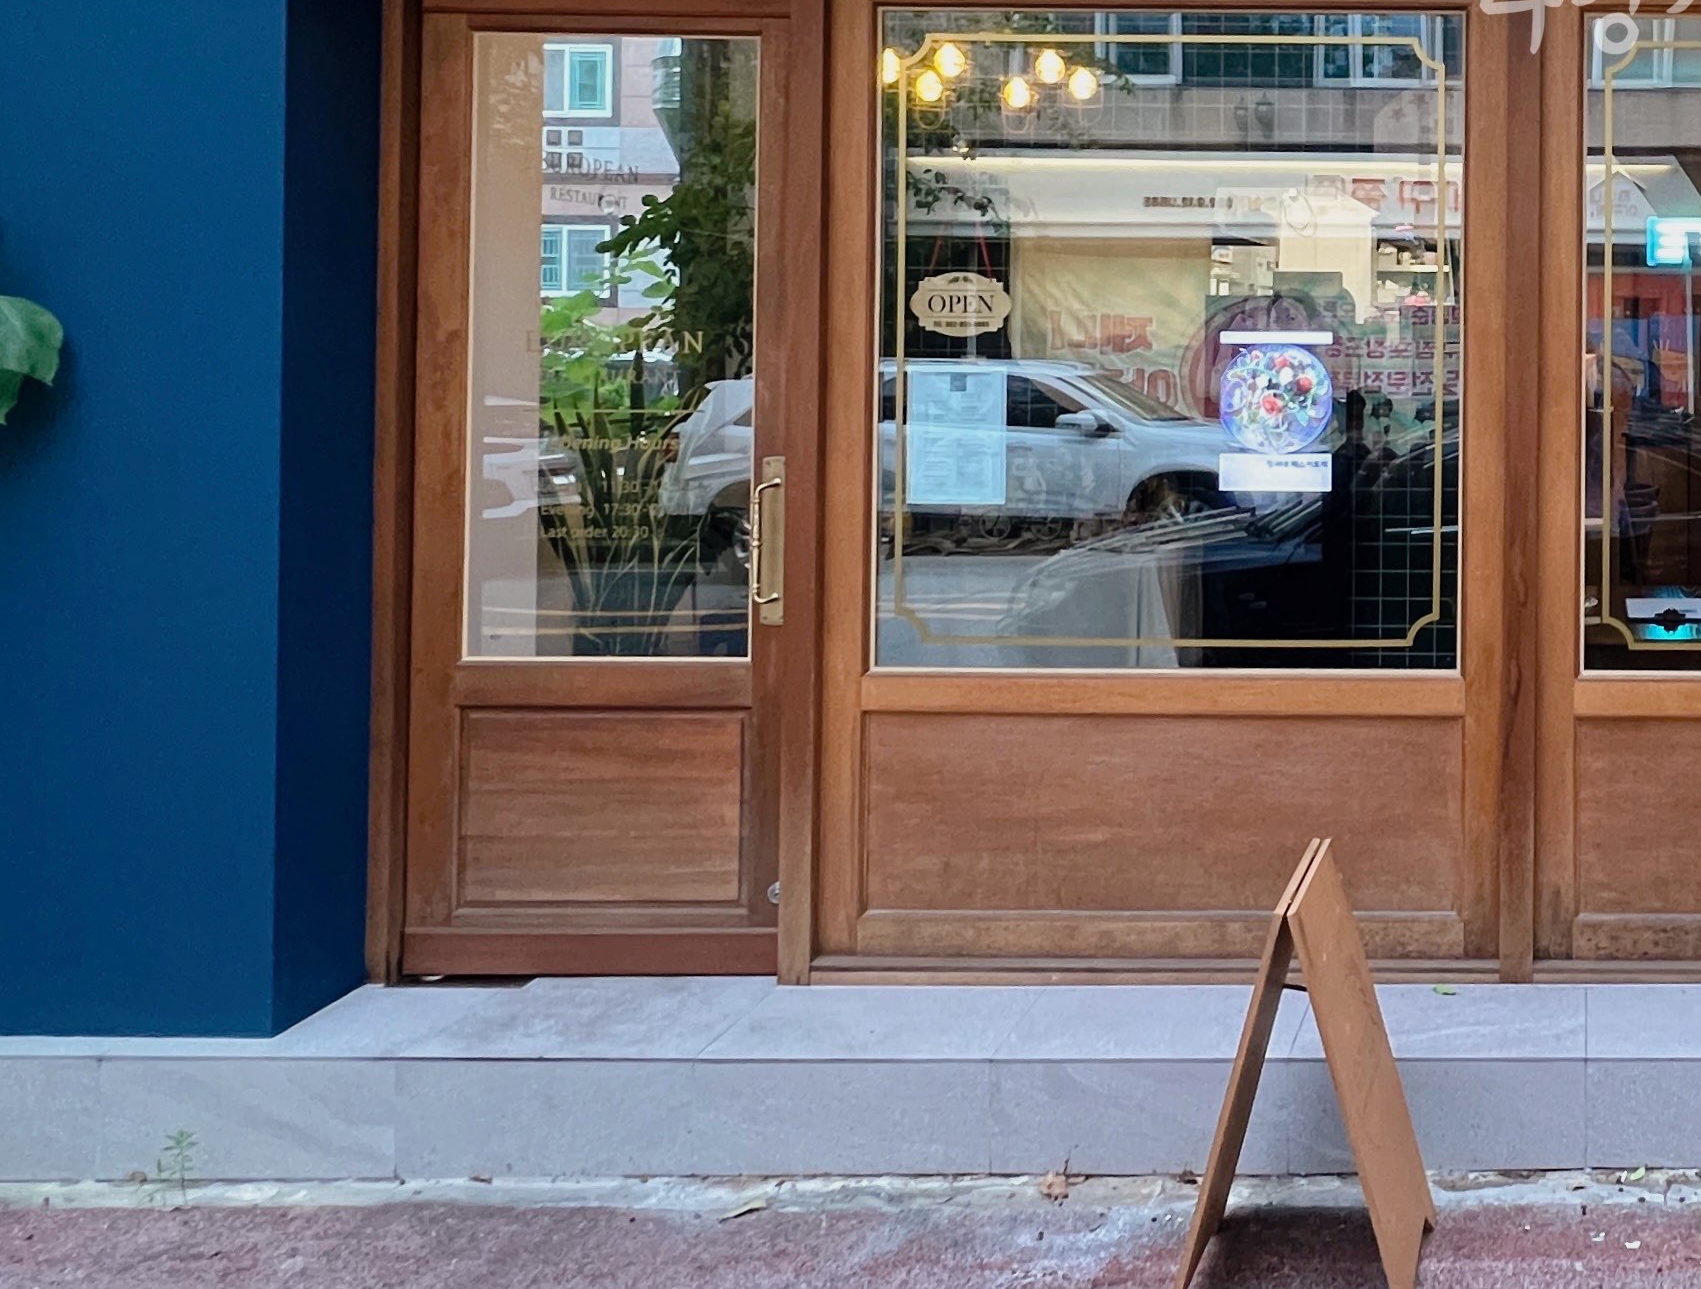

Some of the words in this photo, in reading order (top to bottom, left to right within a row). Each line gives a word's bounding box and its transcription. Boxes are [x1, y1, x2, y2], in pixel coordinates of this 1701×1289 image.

[550, 185, 629, 211] RESTAURNT
[927, 294, 994, 314] OPEN
[526, 329, 705, 355] EPEAN
